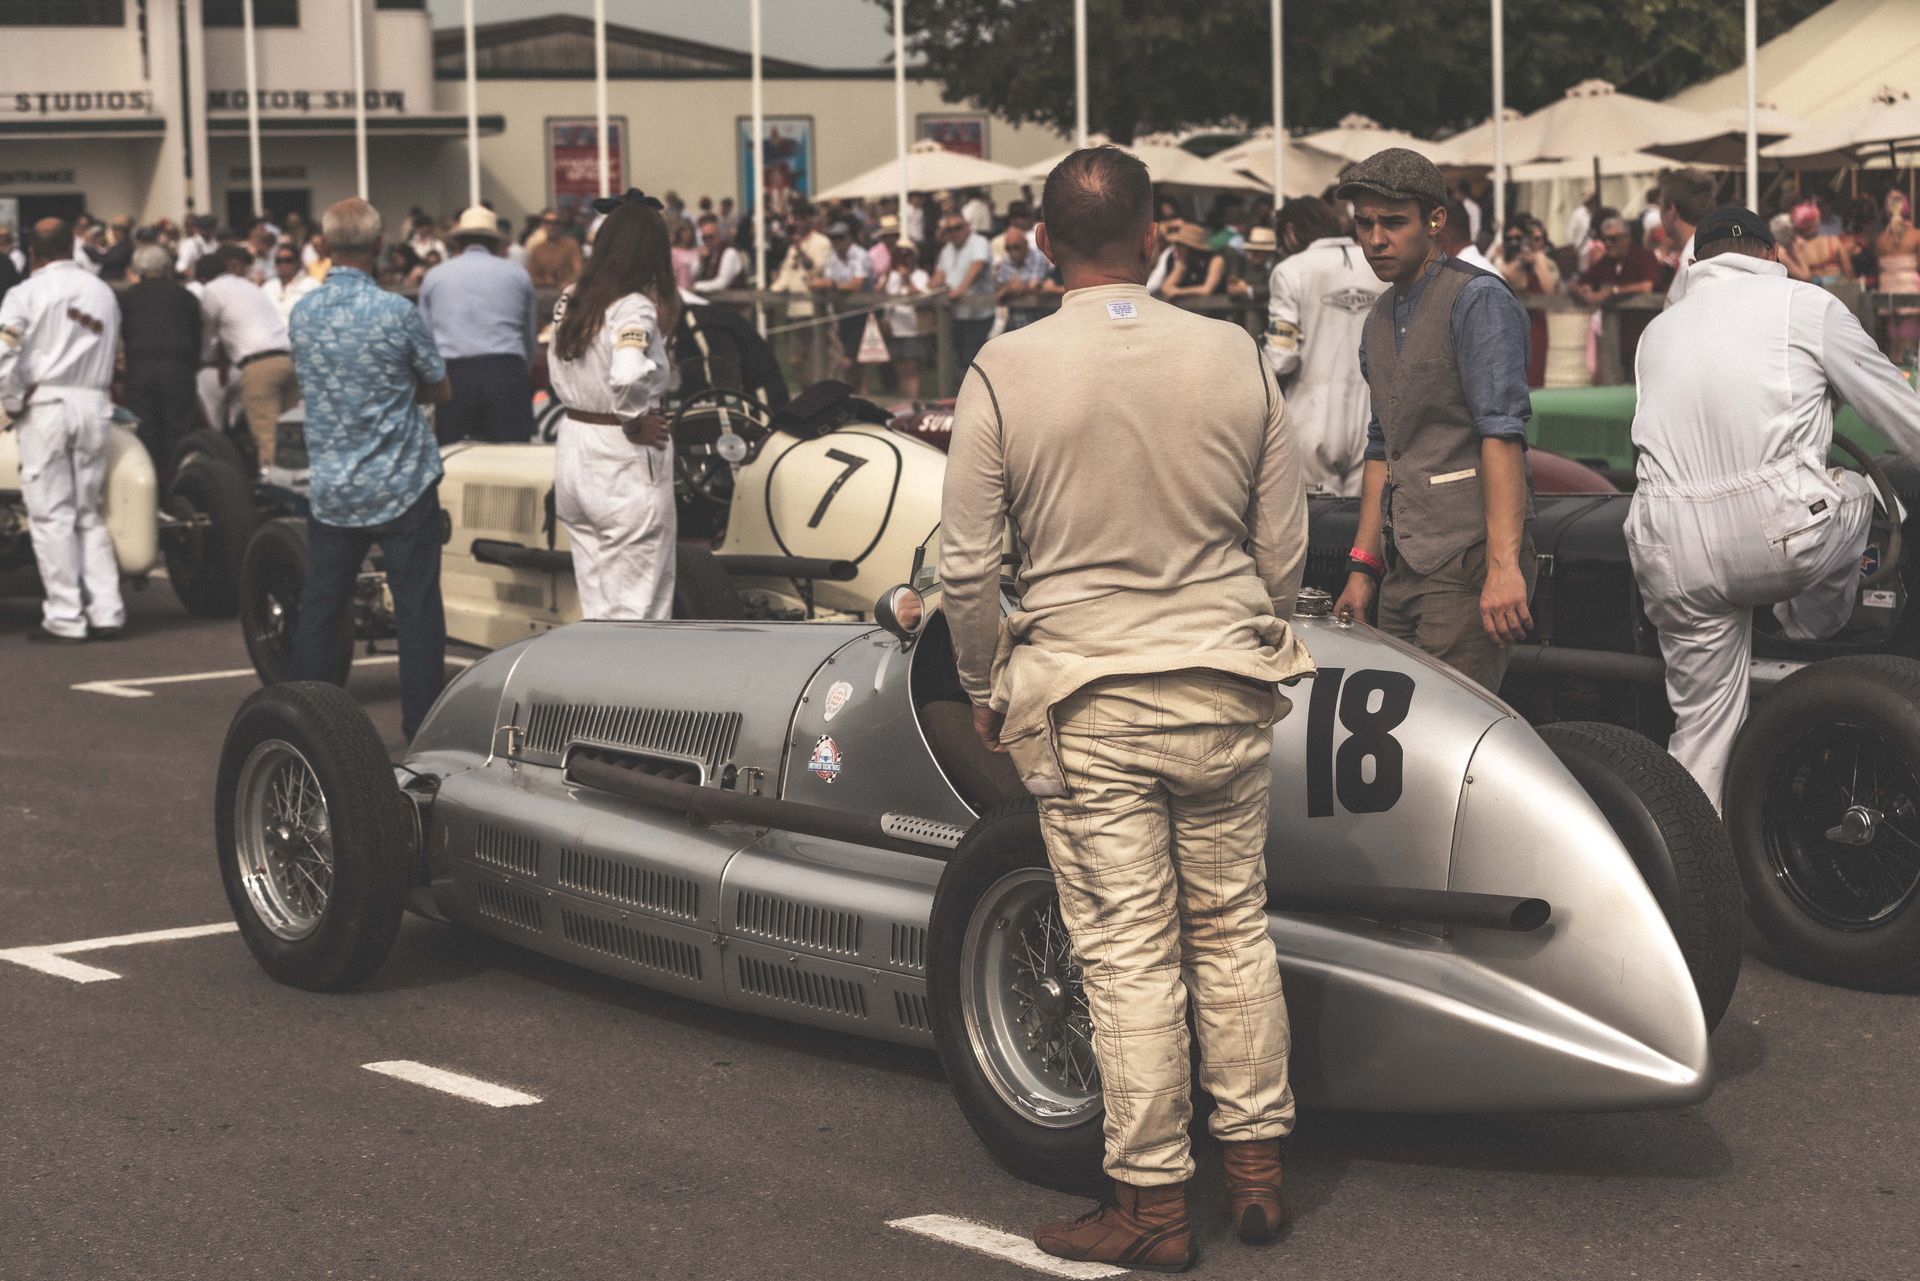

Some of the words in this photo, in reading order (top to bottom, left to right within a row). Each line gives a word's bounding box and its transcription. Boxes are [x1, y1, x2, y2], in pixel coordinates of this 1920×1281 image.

[14, 91, 145, 114] STUDIOS
[206, 90, 310, 112] MOTOR
[324, 89, 406, 112] SHOW
[807, 448, 869, 529] 7
[1306, 667, 1416, 818] 18
